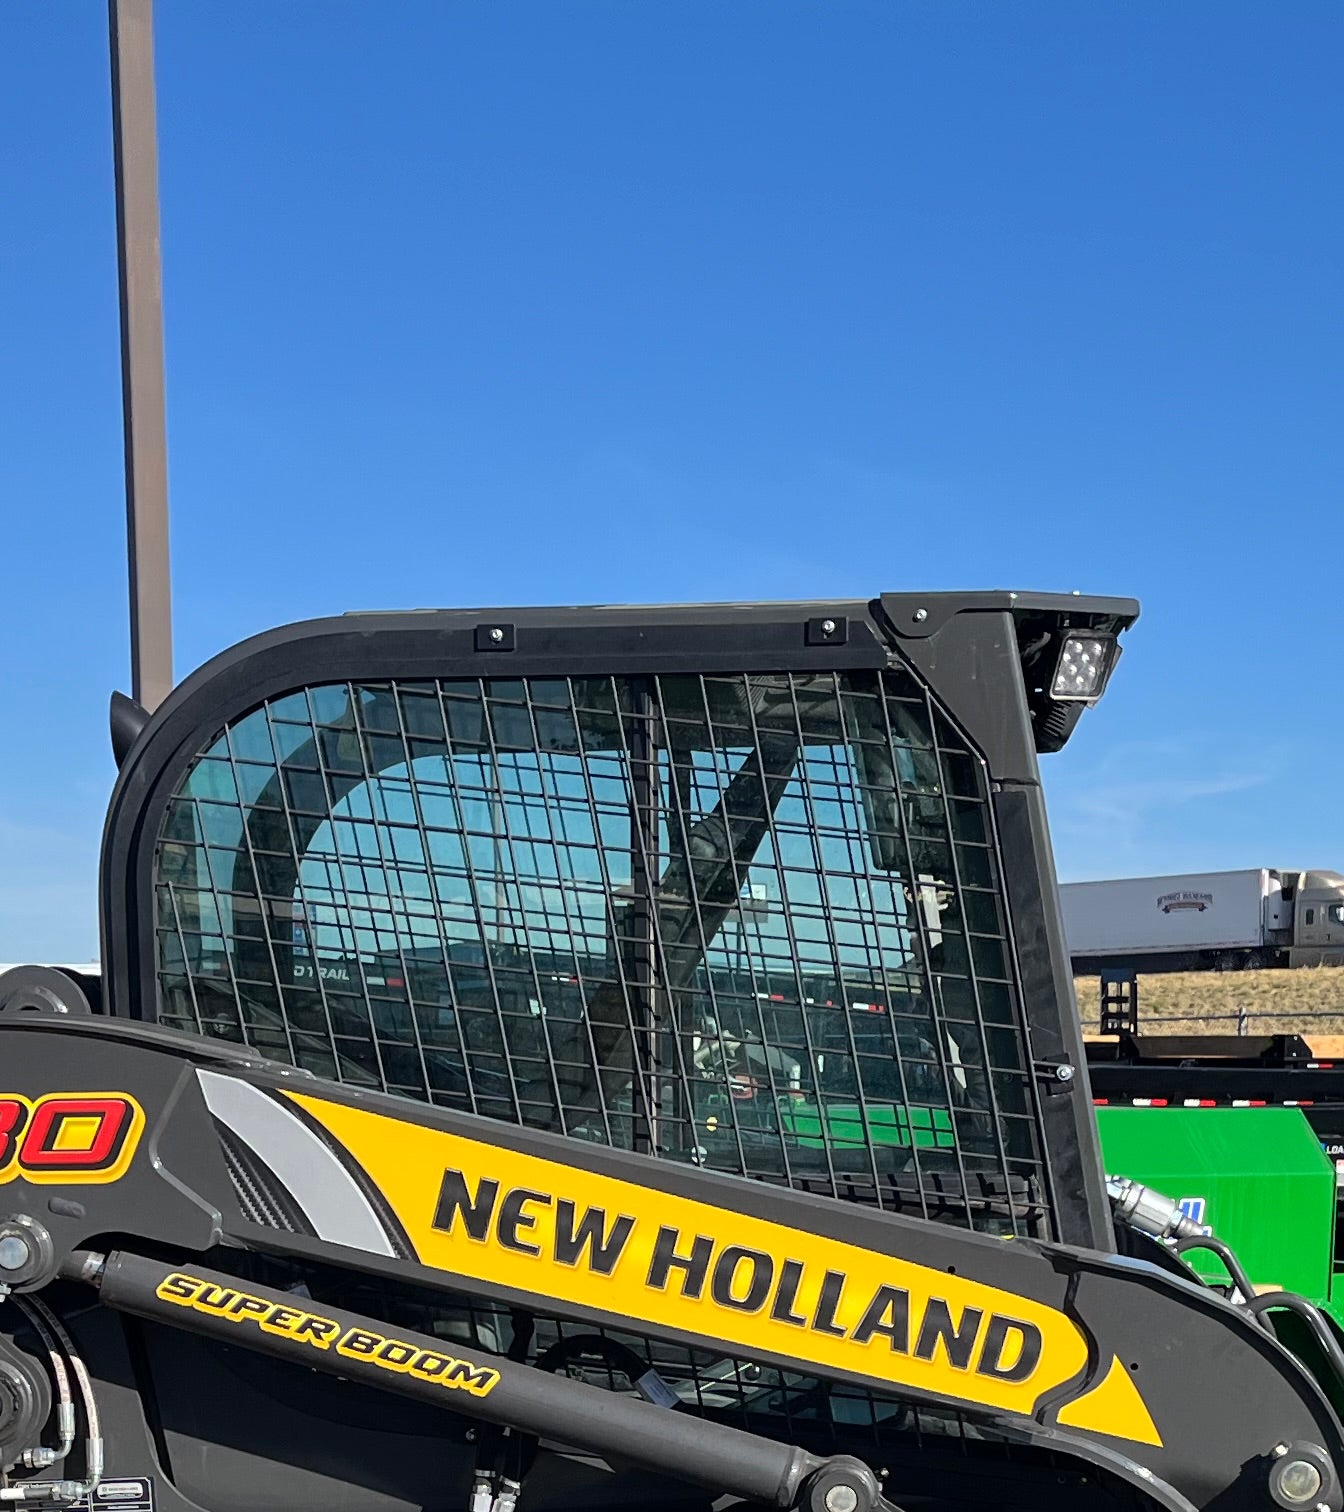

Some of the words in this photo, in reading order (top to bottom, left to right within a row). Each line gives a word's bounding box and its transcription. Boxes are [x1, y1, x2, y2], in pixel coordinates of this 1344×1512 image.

[158, 1274, 339, 1347] SUPER
[338, 1329, 499, 1394] BOOM
[431, 1166, 636, 1278] NEW
[644, 1224, 1045, 1384] HOLLAND
